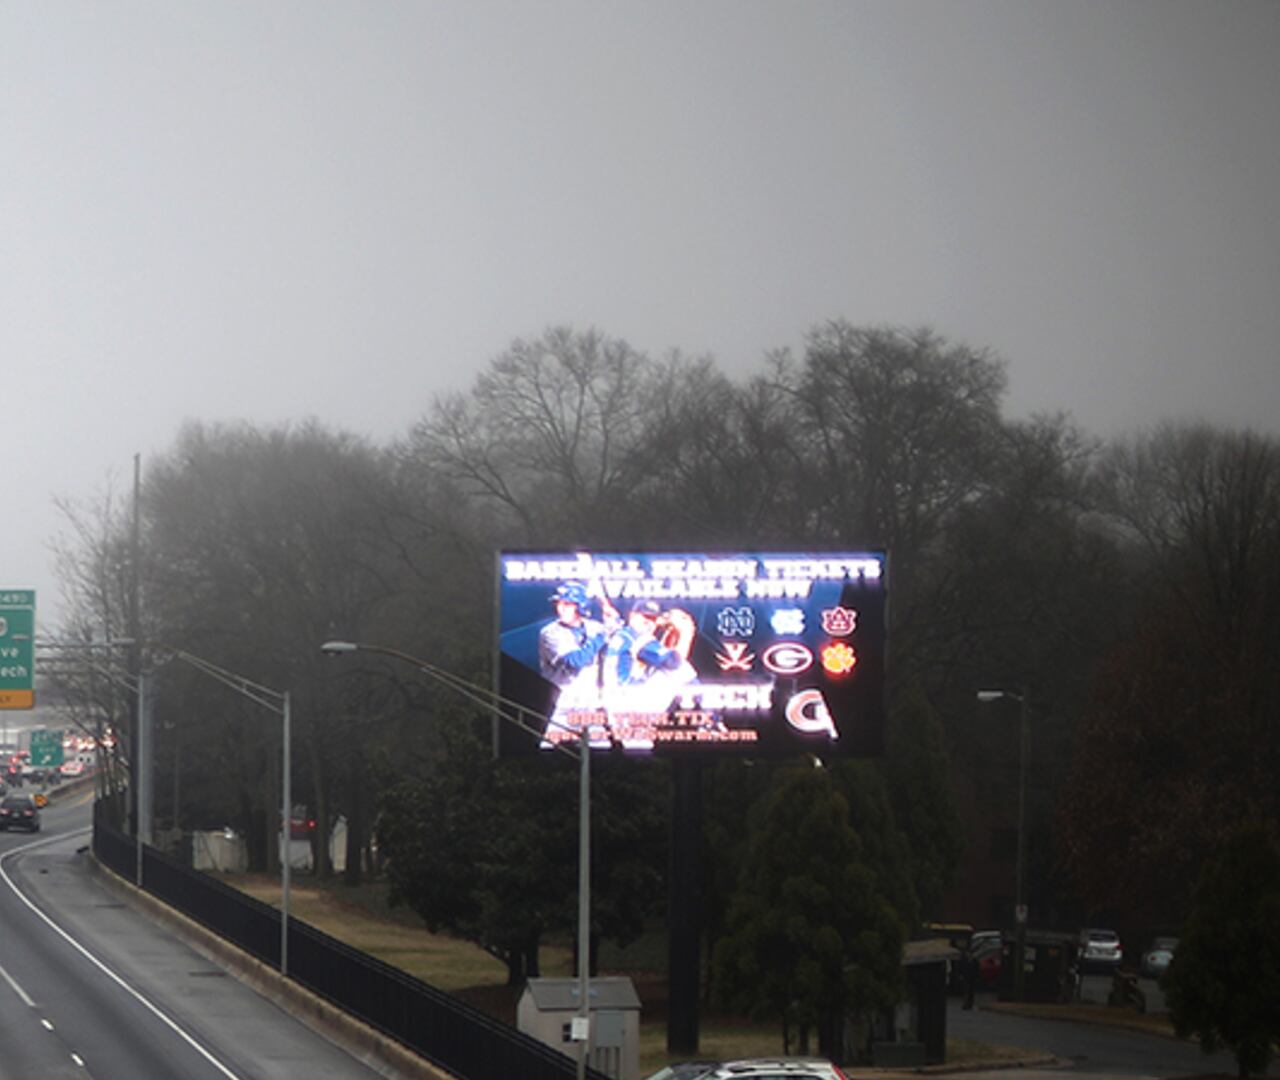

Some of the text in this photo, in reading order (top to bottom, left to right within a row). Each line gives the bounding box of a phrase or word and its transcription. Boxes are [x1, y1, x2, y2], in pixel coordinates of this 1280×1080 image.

[651, 559, 757, 580] SEASON
[762, 559, 881, 580] TICKETS
[586, 579, 813, 598] AVAILABLE NOW
